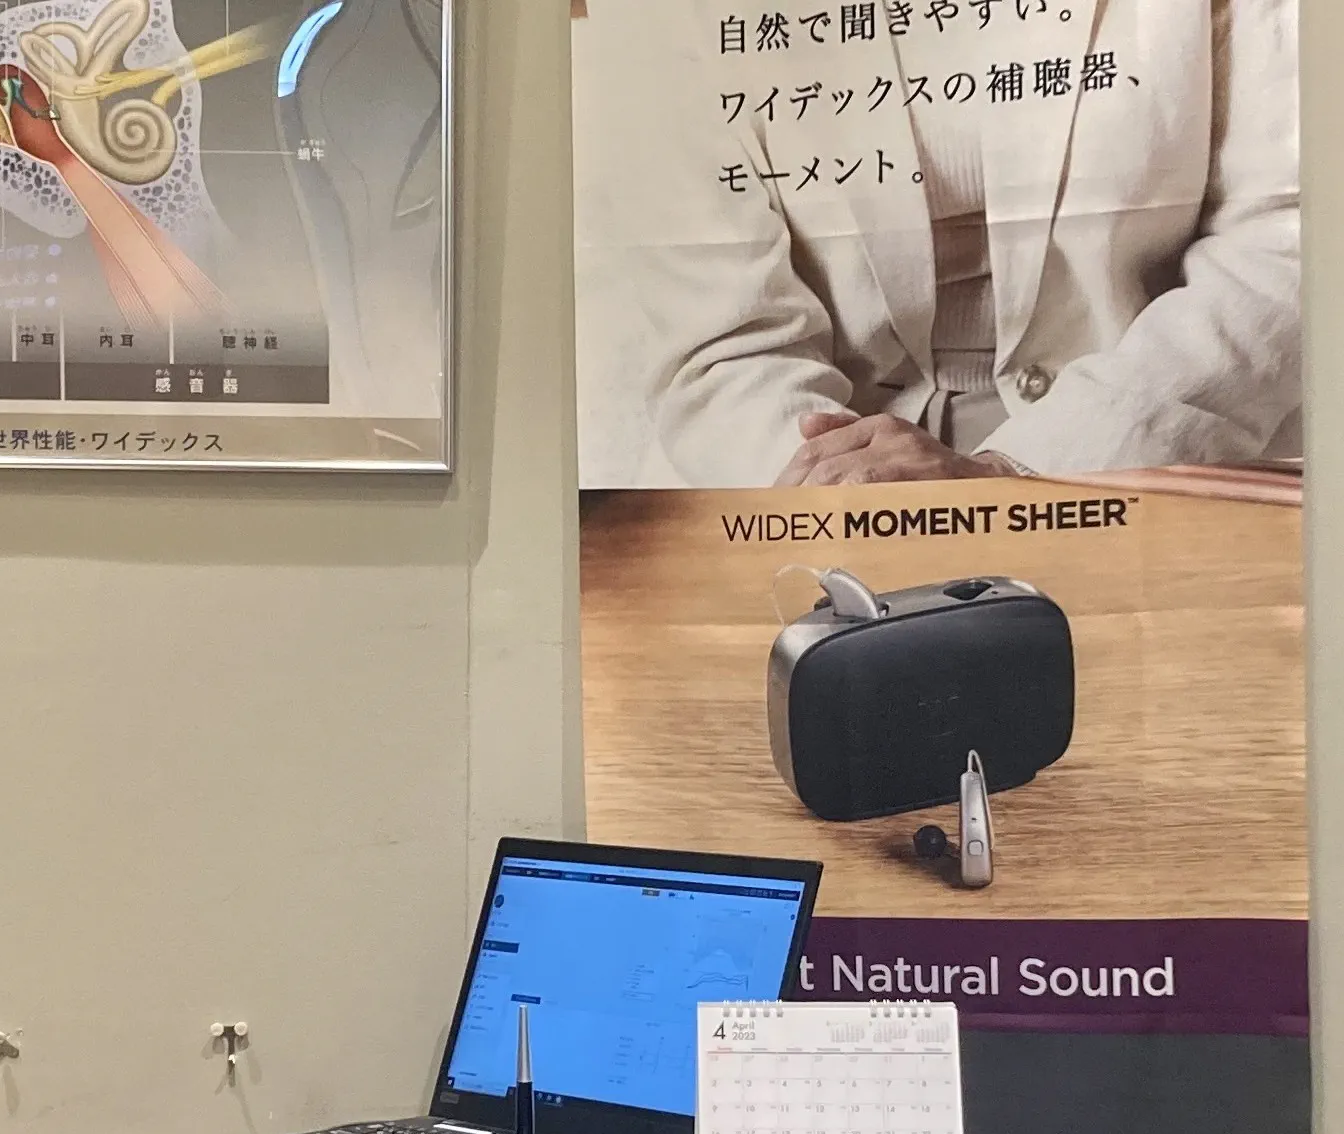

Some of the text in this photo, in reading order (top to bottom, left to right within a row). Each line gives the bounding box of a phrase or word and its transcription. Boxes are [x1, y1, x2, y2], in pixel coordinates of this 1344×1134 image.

[719, 51, 1141, 124] ワイデックスの補聴器、
[718, 149, 925, 193] モーメント。
[721, 512, 834, 542] WIDEX
[844, 506, 998, 539] MOMENT
[832, 954, 1000, 996] Natural
[1019, 956, 1175, 997] Sound
[712, 1021, 755, 1039] 4 April
[732, 1032, 756, 1040] 2023
